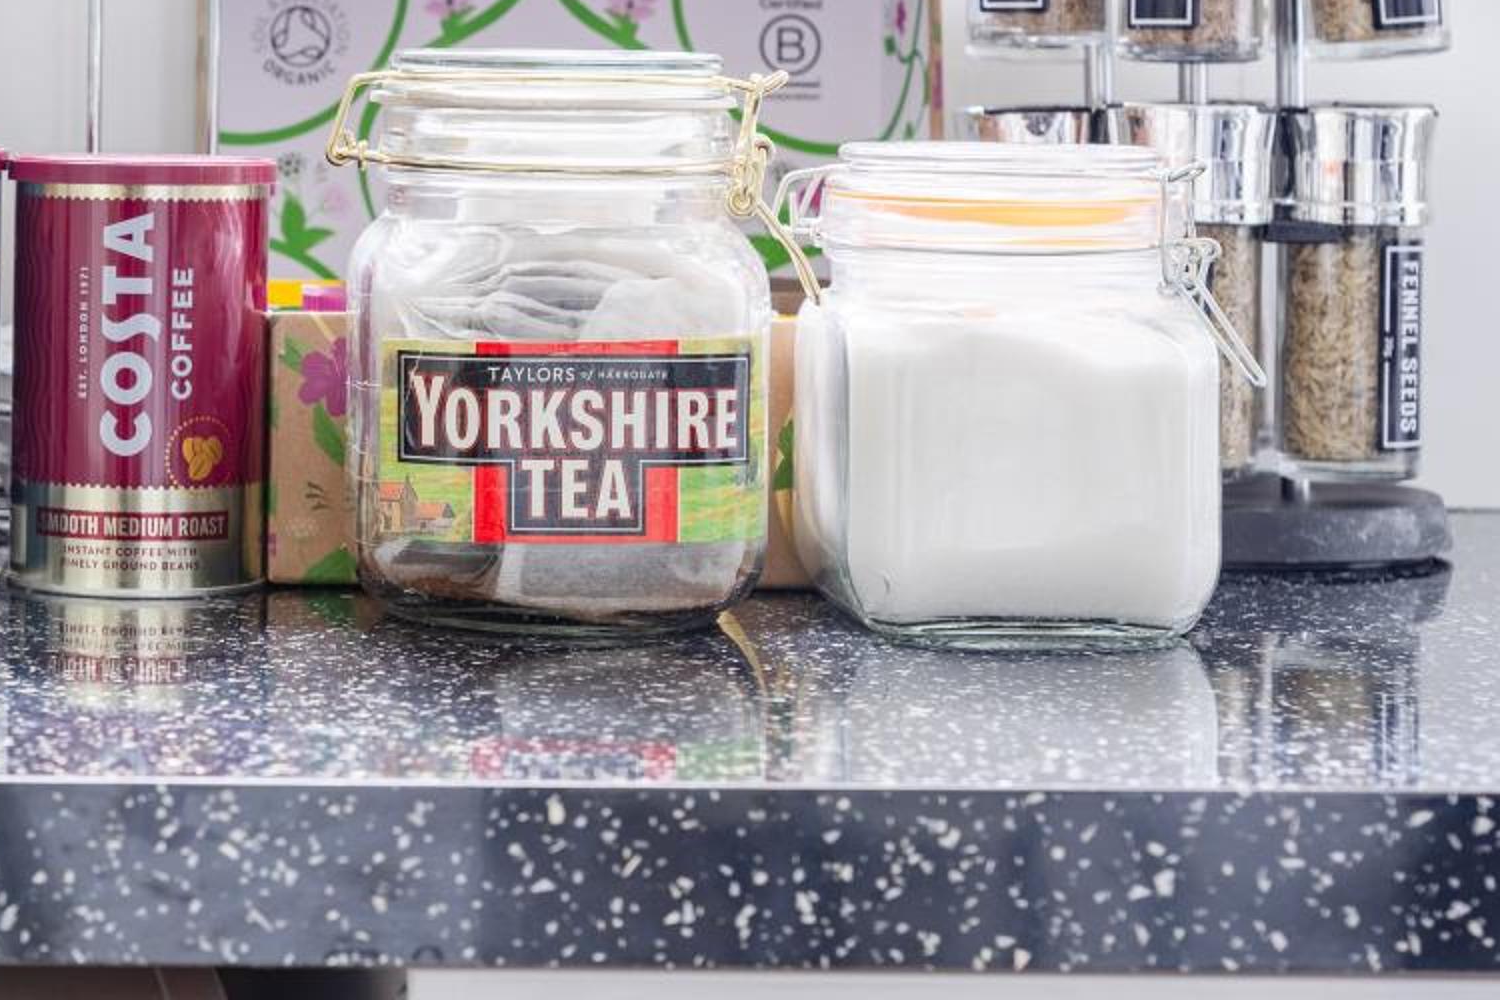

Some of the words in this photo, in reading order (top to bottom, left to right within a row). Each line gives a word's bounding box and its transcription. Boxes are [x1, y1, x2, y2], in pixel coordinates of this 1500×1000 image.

[263, 58, 336, 85] ORGANIC
[79, 302, 88, 363] LONDON
[100, 212, 162, 456] COSTA
[171, 268, 193, 400] COFFEE
[1401, 260, 1421, 350] FENNEL
[487, 366, 576, 383] TAYLORS
[598, 370, 668, 380] HARROGATE
[1400, 360, 1419, 435] SEEDS
[408, 372, 738, 451] YORKSHIRE
[521, 459, 632, 520] TEA
[64, 545, 110, 556] INSTANT
[116, 547, 161, 558] COFFEE
[167, 547, 197, 556] WITH
[104, 517, 172, 537] MEDIUM
[178, 516, 225, 536] ROAST
[103, 560, 157, 571] GROUND
[162, 561, 198, 571] BEANS
